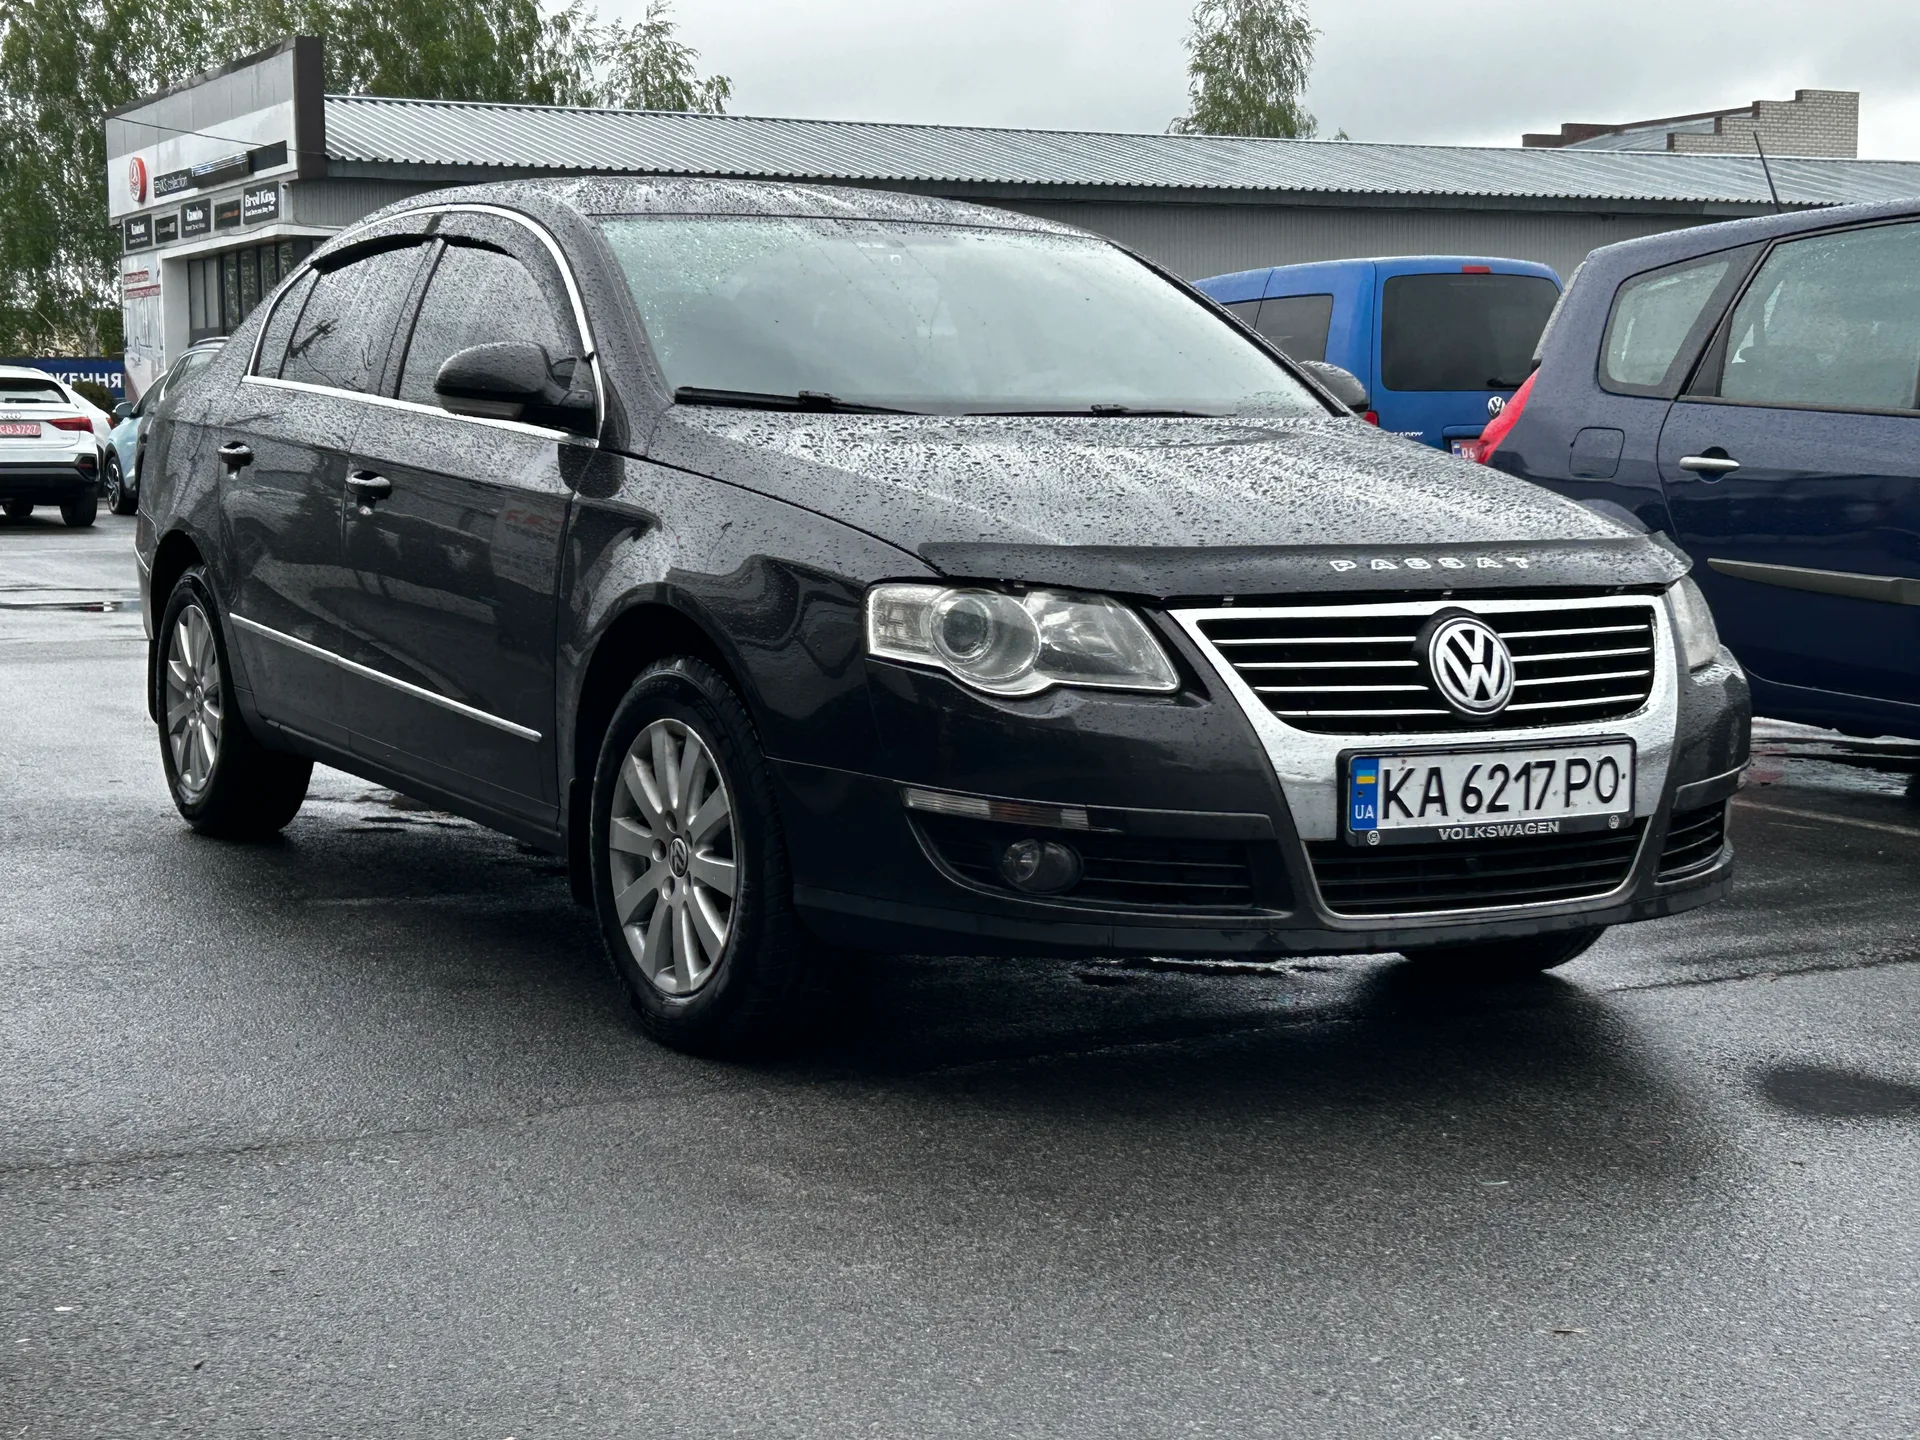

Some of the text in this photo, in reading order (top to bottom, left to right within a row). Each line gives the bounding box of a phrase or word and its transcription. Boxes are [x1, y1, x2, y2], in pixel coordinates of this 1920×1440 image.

[1329, 557, 1530, 572] PASSAT
[1381, 755, 1619, 820] KA 6217 PO
[1354, 805, 1375, 820] UA
[1437, 821, 1561, 841] VOLKSWAGEN
